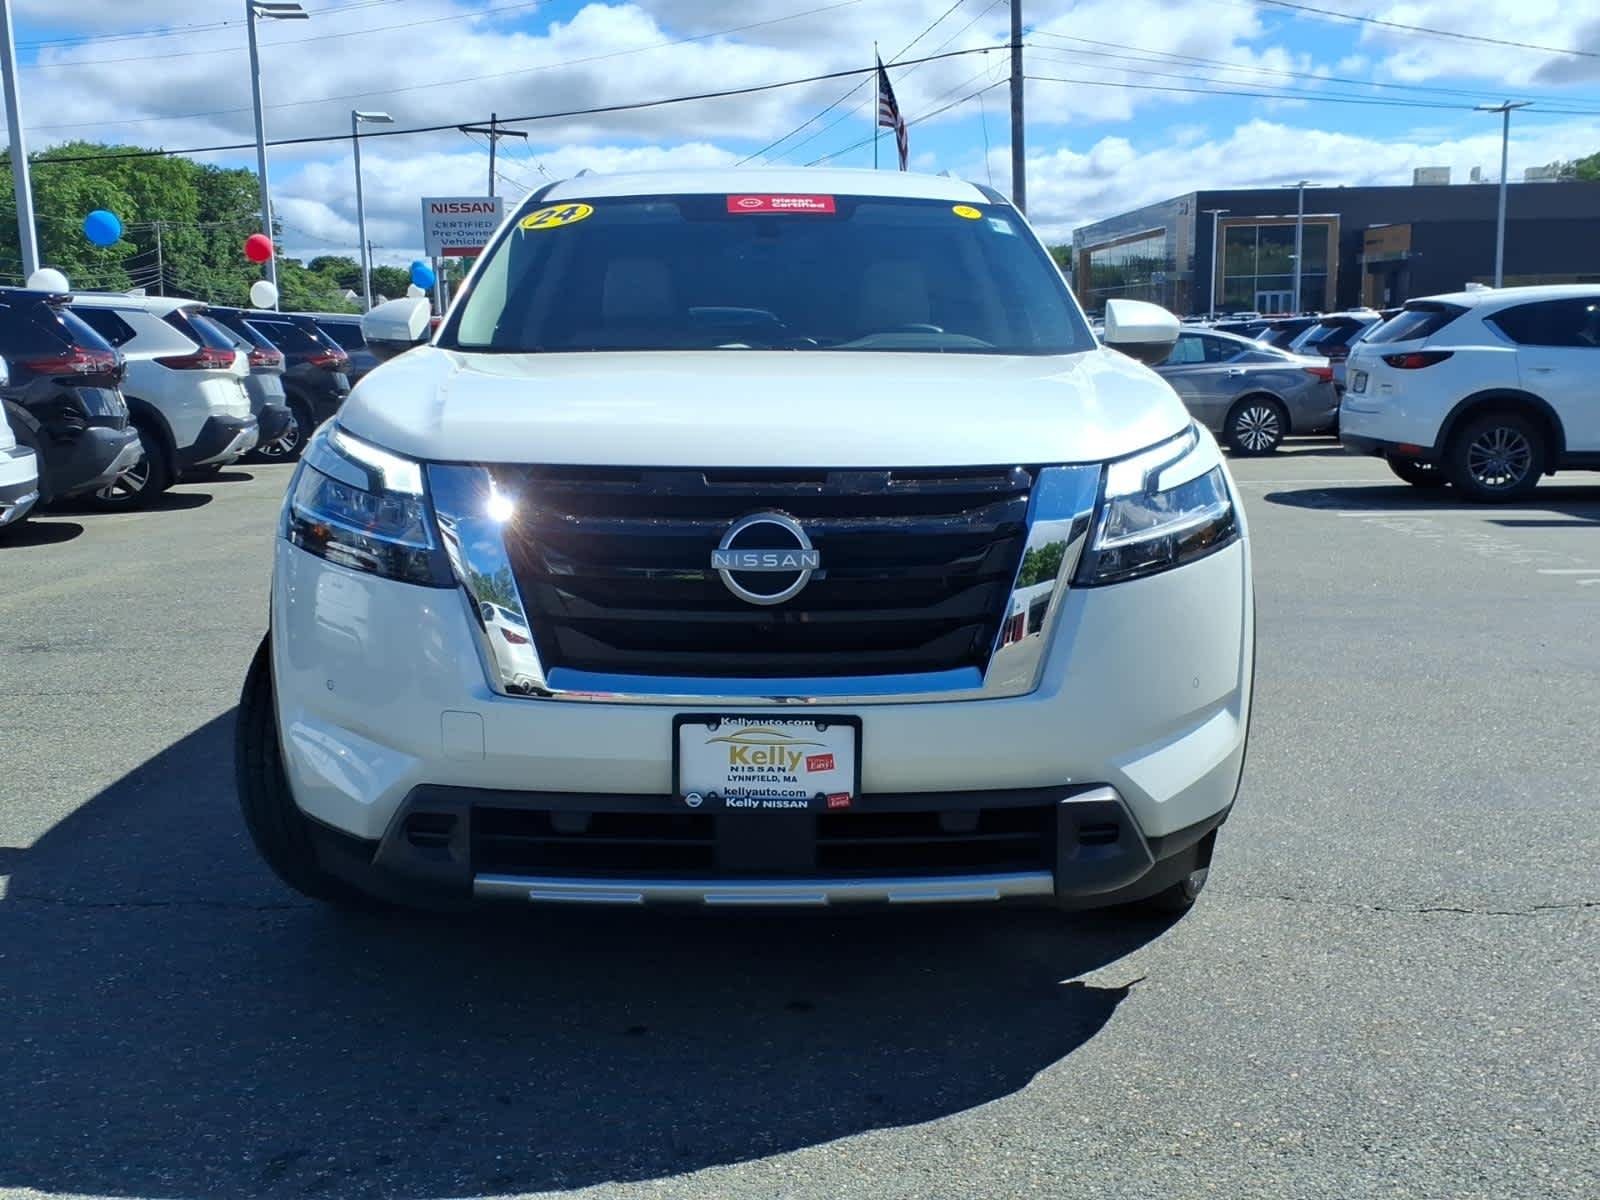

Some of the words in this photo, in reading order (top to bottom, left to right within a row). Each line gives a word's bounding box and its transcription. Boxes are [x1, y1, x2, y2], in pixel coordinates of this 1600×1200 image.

[431, 203, 495, 213] NISSAN
[528, 207, 577, 226] 24
[435, 221, 492, 229] CERTIFIED
[714, 554, 817, 567] NISSAN
[721, 717, 816, 727] Kellyauto.com
[729, 745, 803, 772] Kelly
[727, 775, 780, 783] LYNNFIELD,
[783, 775, 798, 783] MA
[724, 787, 807, 798] kellyauto.com
[726, 798, 760, 808] Kelly
[762, 800, 808, 808] NISSAN
